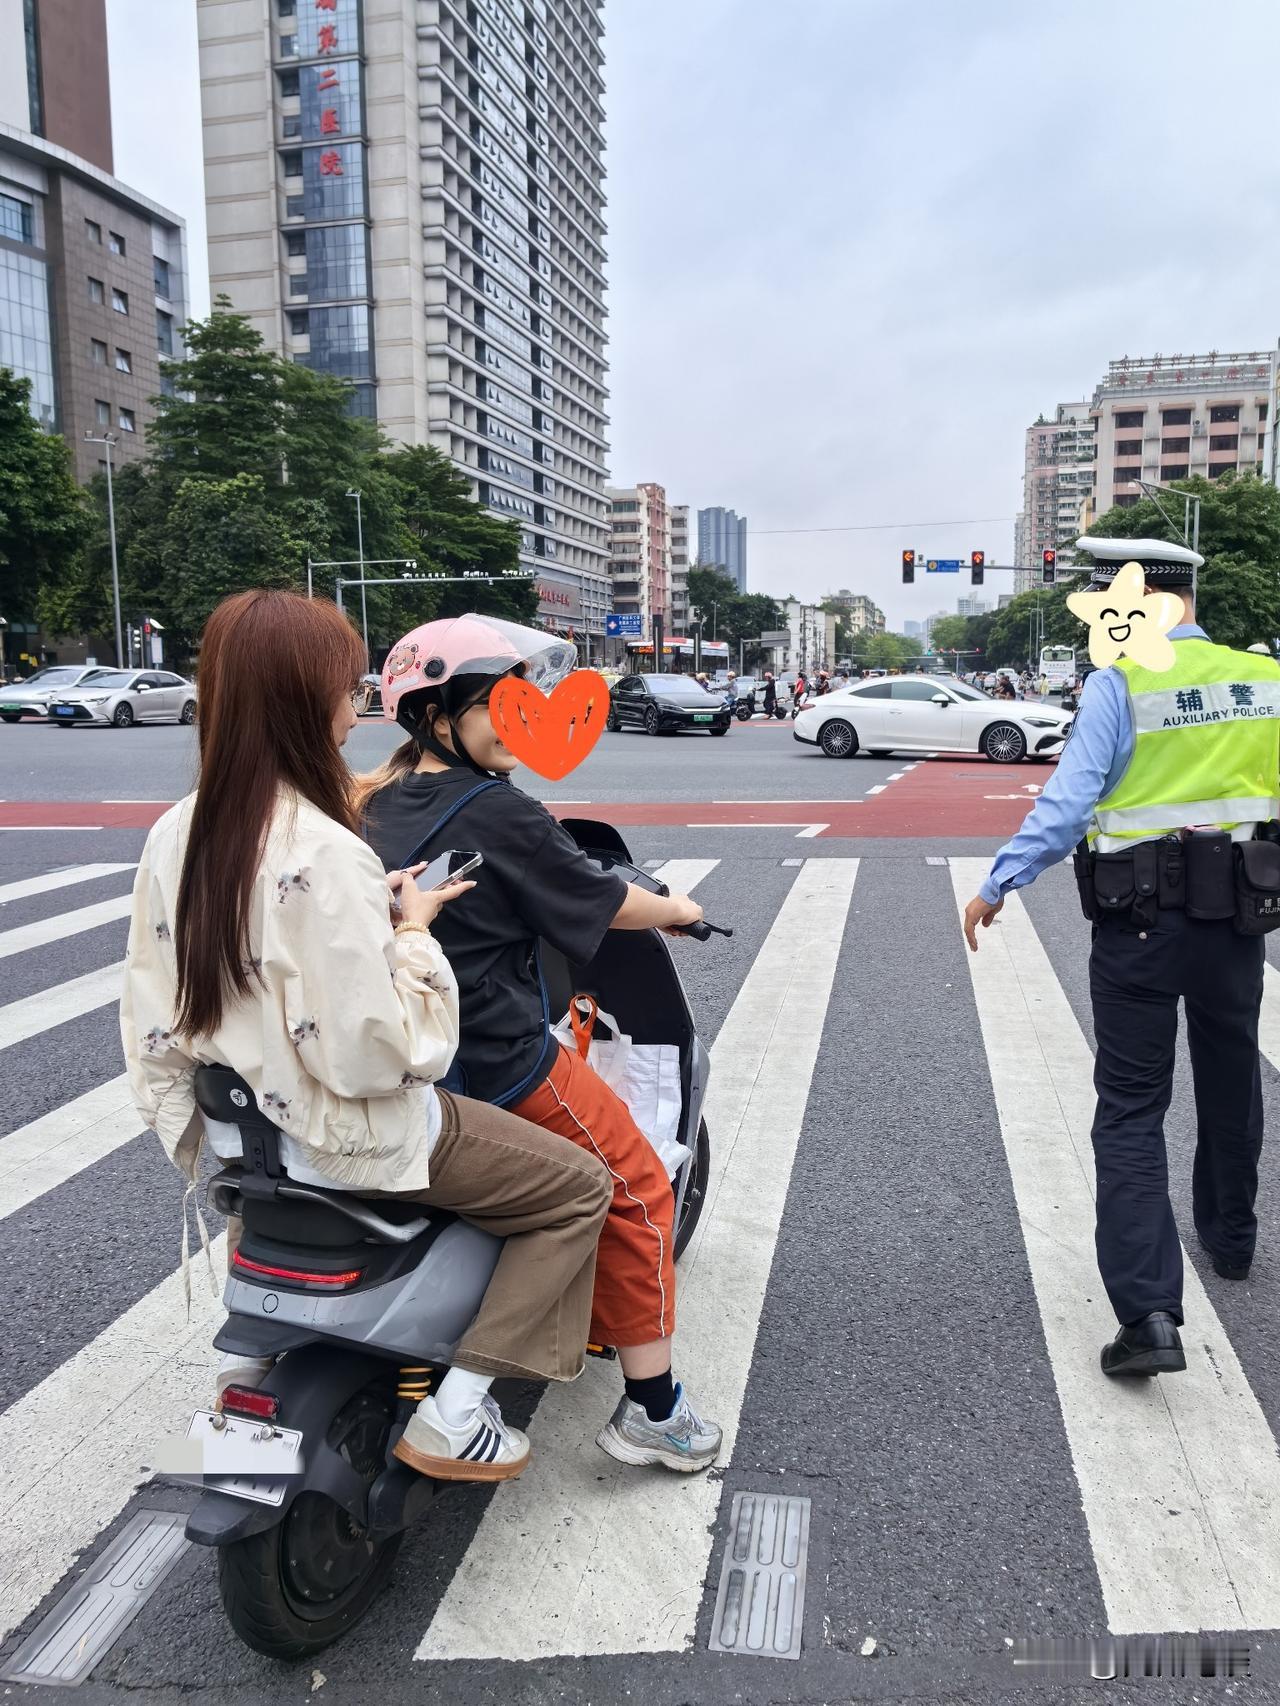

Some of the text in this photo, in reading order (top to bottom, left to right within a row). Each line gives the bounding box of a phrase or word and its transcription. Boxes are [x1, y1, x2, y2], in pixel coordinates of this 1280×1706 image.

[1175, 683, 1255, 713] 辅警
[1163, 705, 1275, 727] AUXILIARY POLICE
